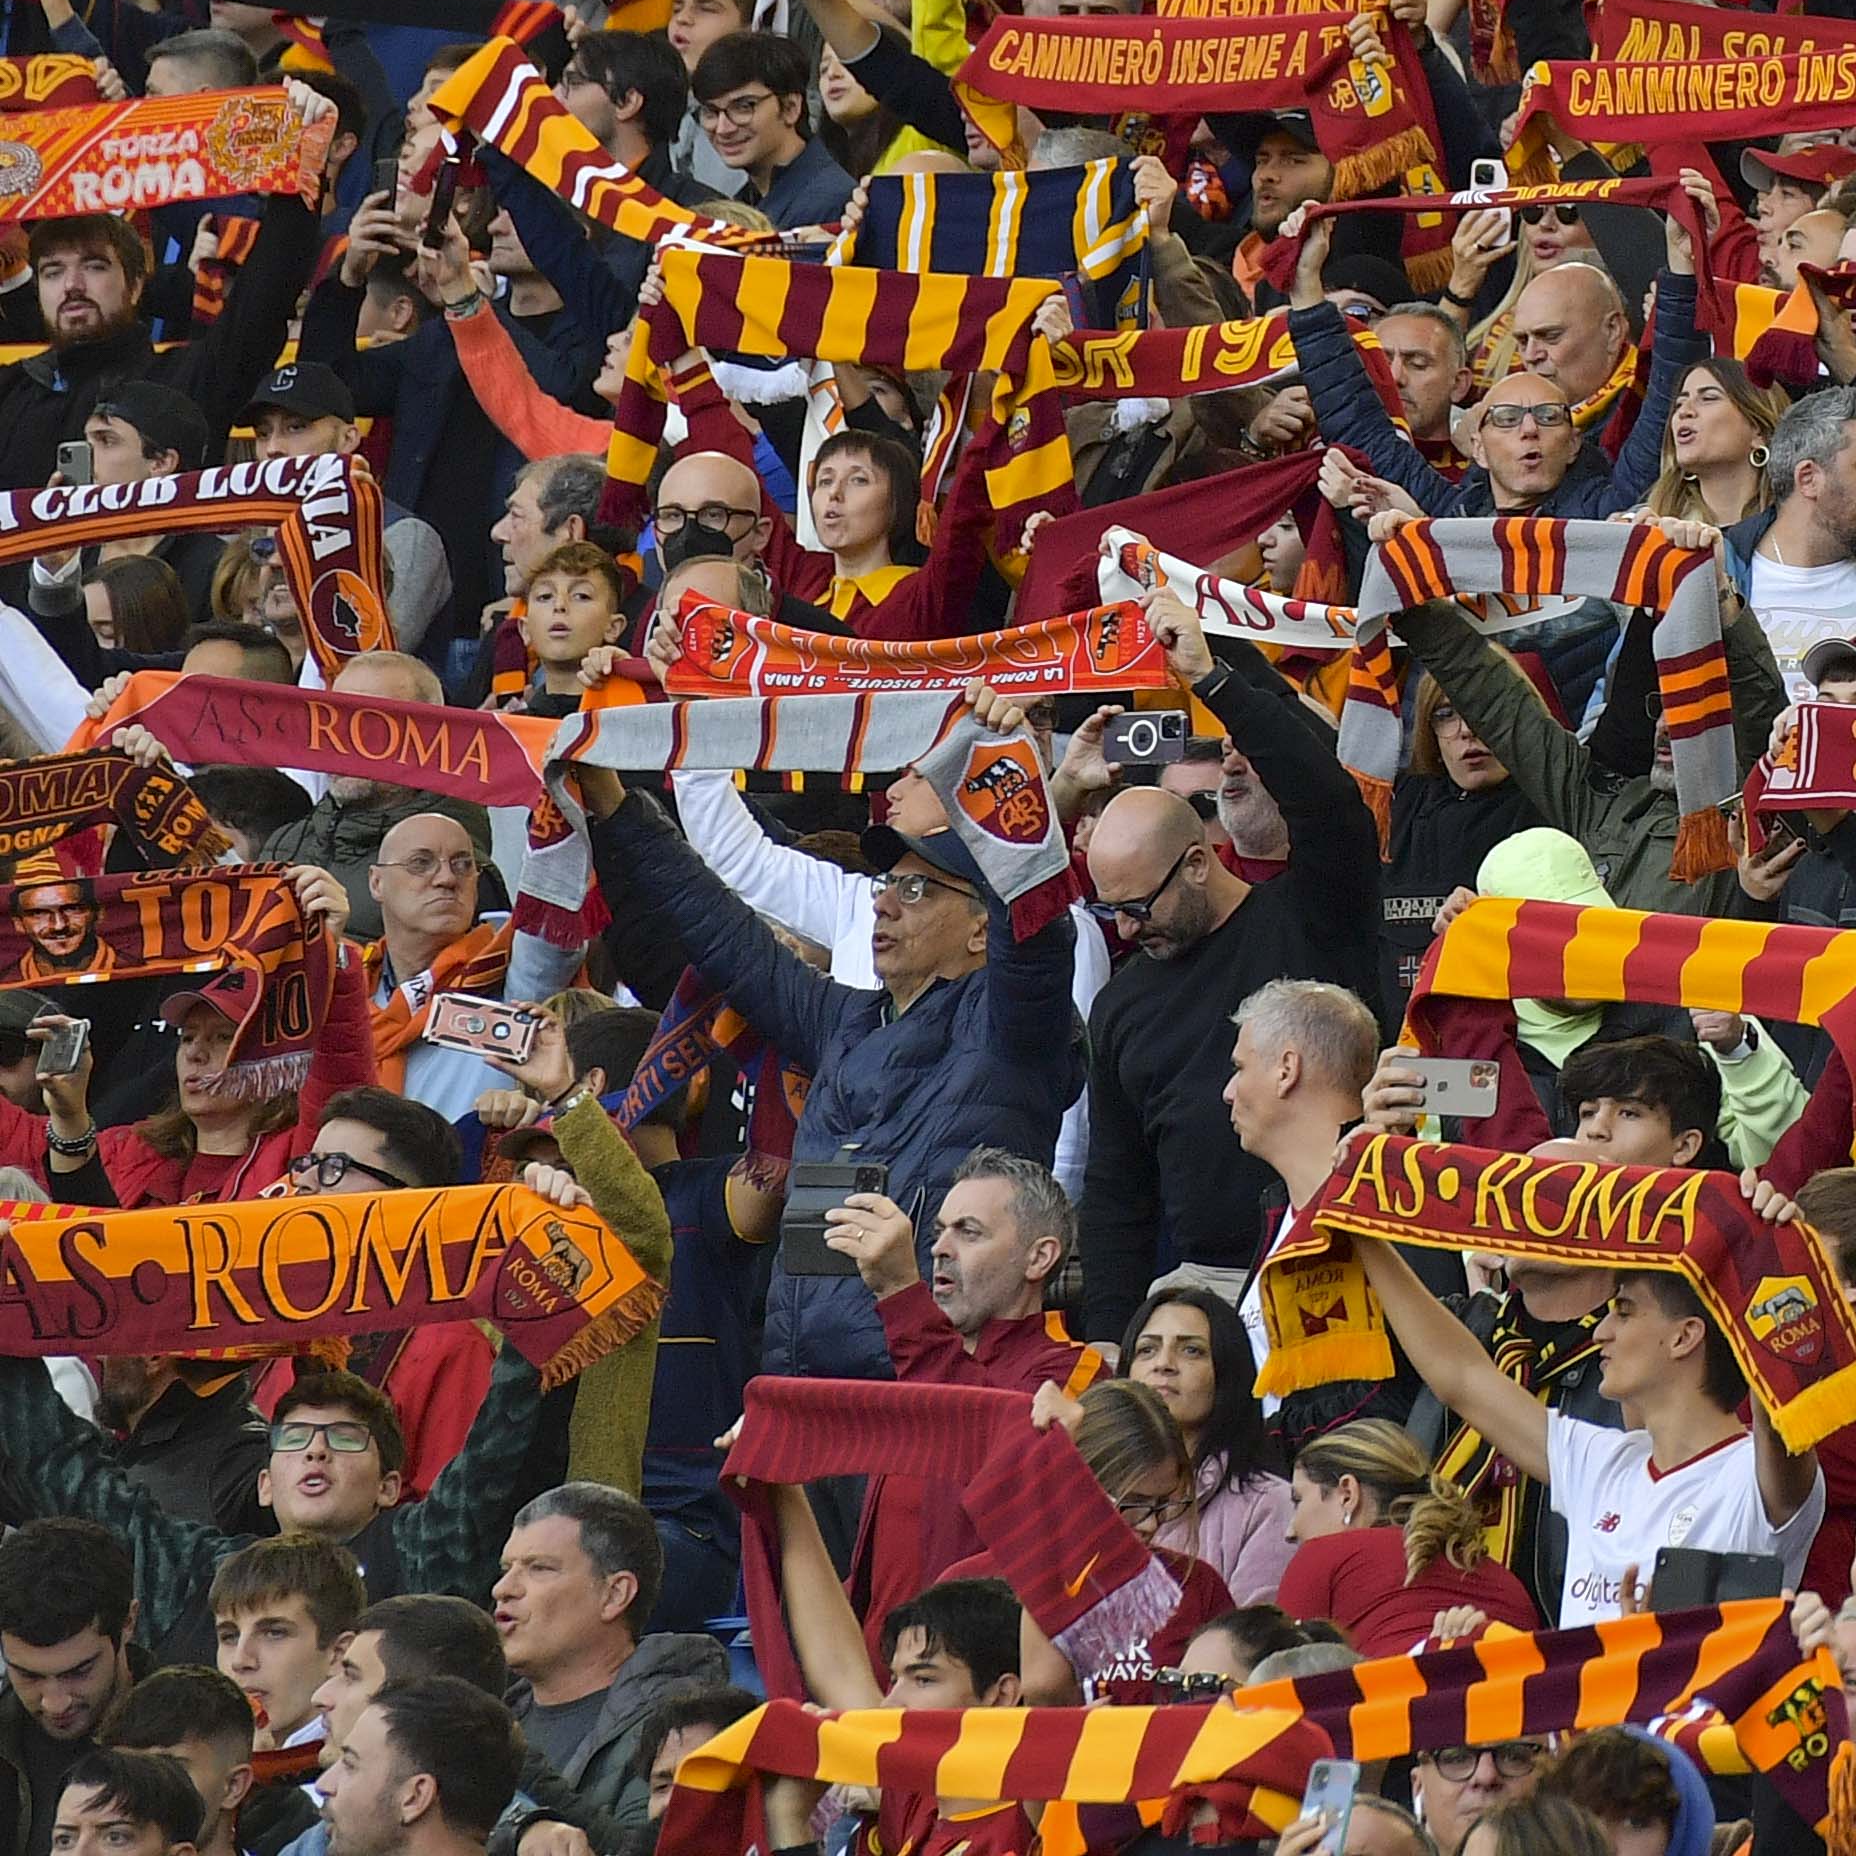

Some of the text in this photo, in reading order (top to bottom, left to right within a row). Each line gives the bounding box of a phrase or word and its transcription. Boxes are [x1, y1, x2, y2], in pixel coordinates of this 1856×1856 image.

[988, 26, 1308, 86] CAMMINERÒ INSIEME A
[1568, 54, 1784, 118] CAMMINERÒ
[69, 130, 202, 210] FORZA ROMA
[31, 473, 177, 521] CLUB
[763, 672, 802, 688] AMA
[806, 673, 827, 689] SI
[990, 668, 1038, 687] ROMA
[1043, 666, 1064, 682] LA
[306, 698, 494, 784] ROMA
[1337, 1133, 1710, 1249] AS ROMA
[173, 1189, 521, 1330] ROMA
[506, 1256, 559, 1318] ROMA
[1771, 1317, 1822, 1356] ROMA
